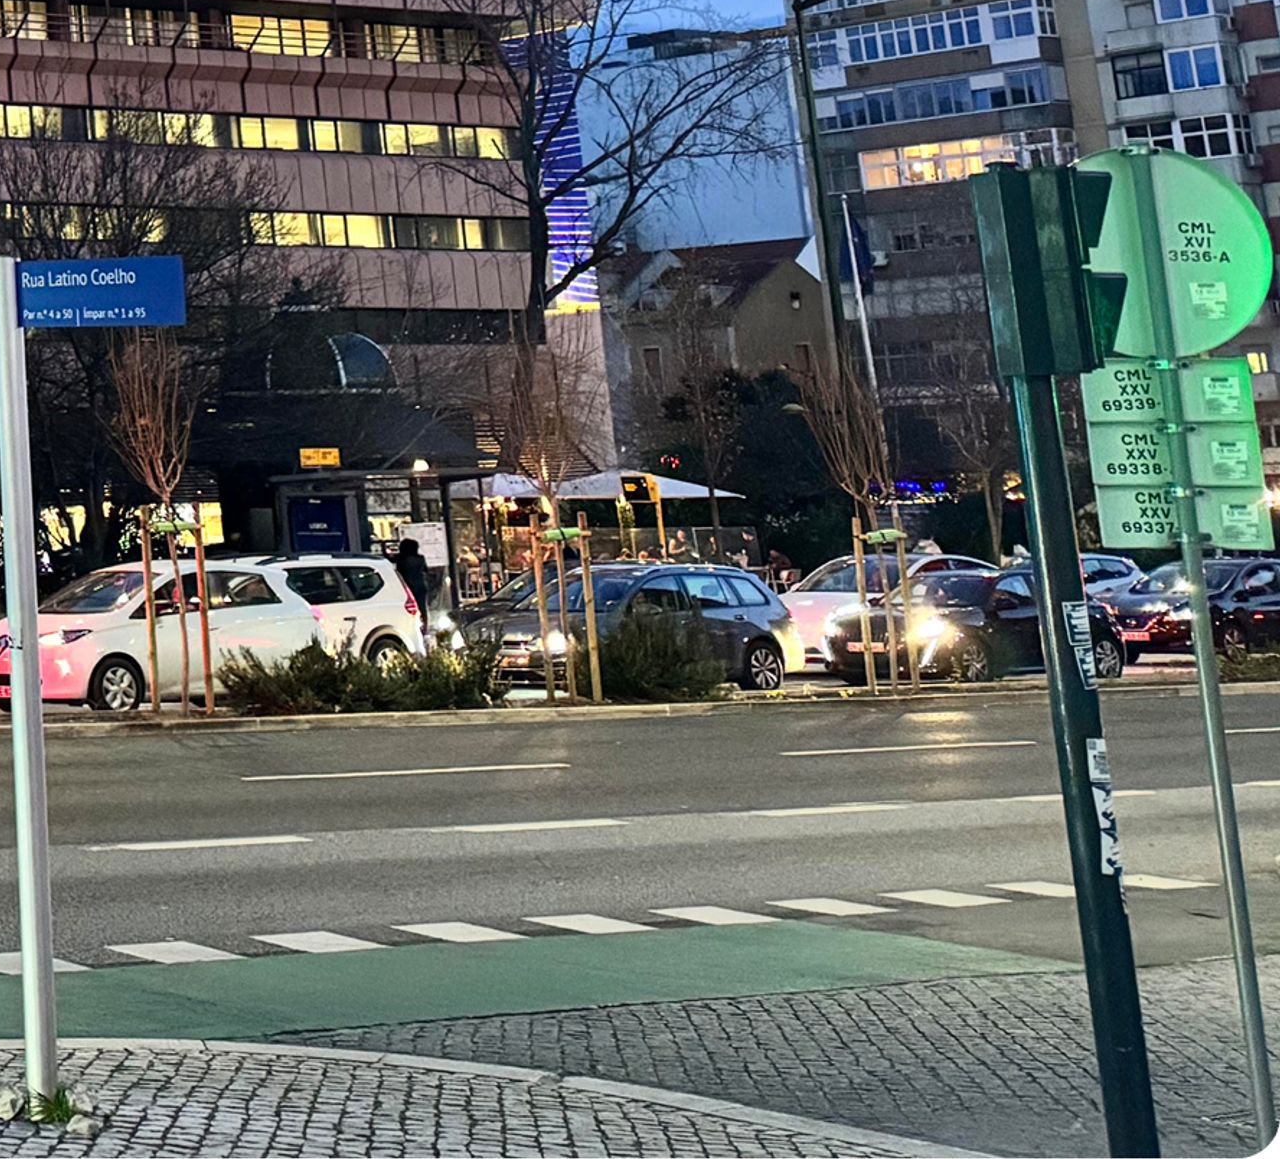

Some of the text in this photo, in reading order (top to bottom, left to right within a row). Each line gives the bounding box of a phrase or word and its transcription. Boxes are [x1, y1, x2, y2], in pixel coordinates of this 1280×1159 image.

[1177, 221, 1216, 234] CML
[1184, 236, 1211, 248] XVI
[1168, 249, 1230, 263] 3536-A
[21, 268, 136, 288] Rua Latino Coelho
[23, 309, 36, 320] Par
[62, 309, 74, 319] 50
[134, 307, 146, 318] 95
[1114, 369, 1153, 382] CML
[1119, 383, 1151, 396] XXV
[1121, 433, 1160, 446] CML
[1126, 448, 1157, 461] XXV
[1134, 491, 1174, 505] CML
[1139, 506, 1171, 519] XXV
